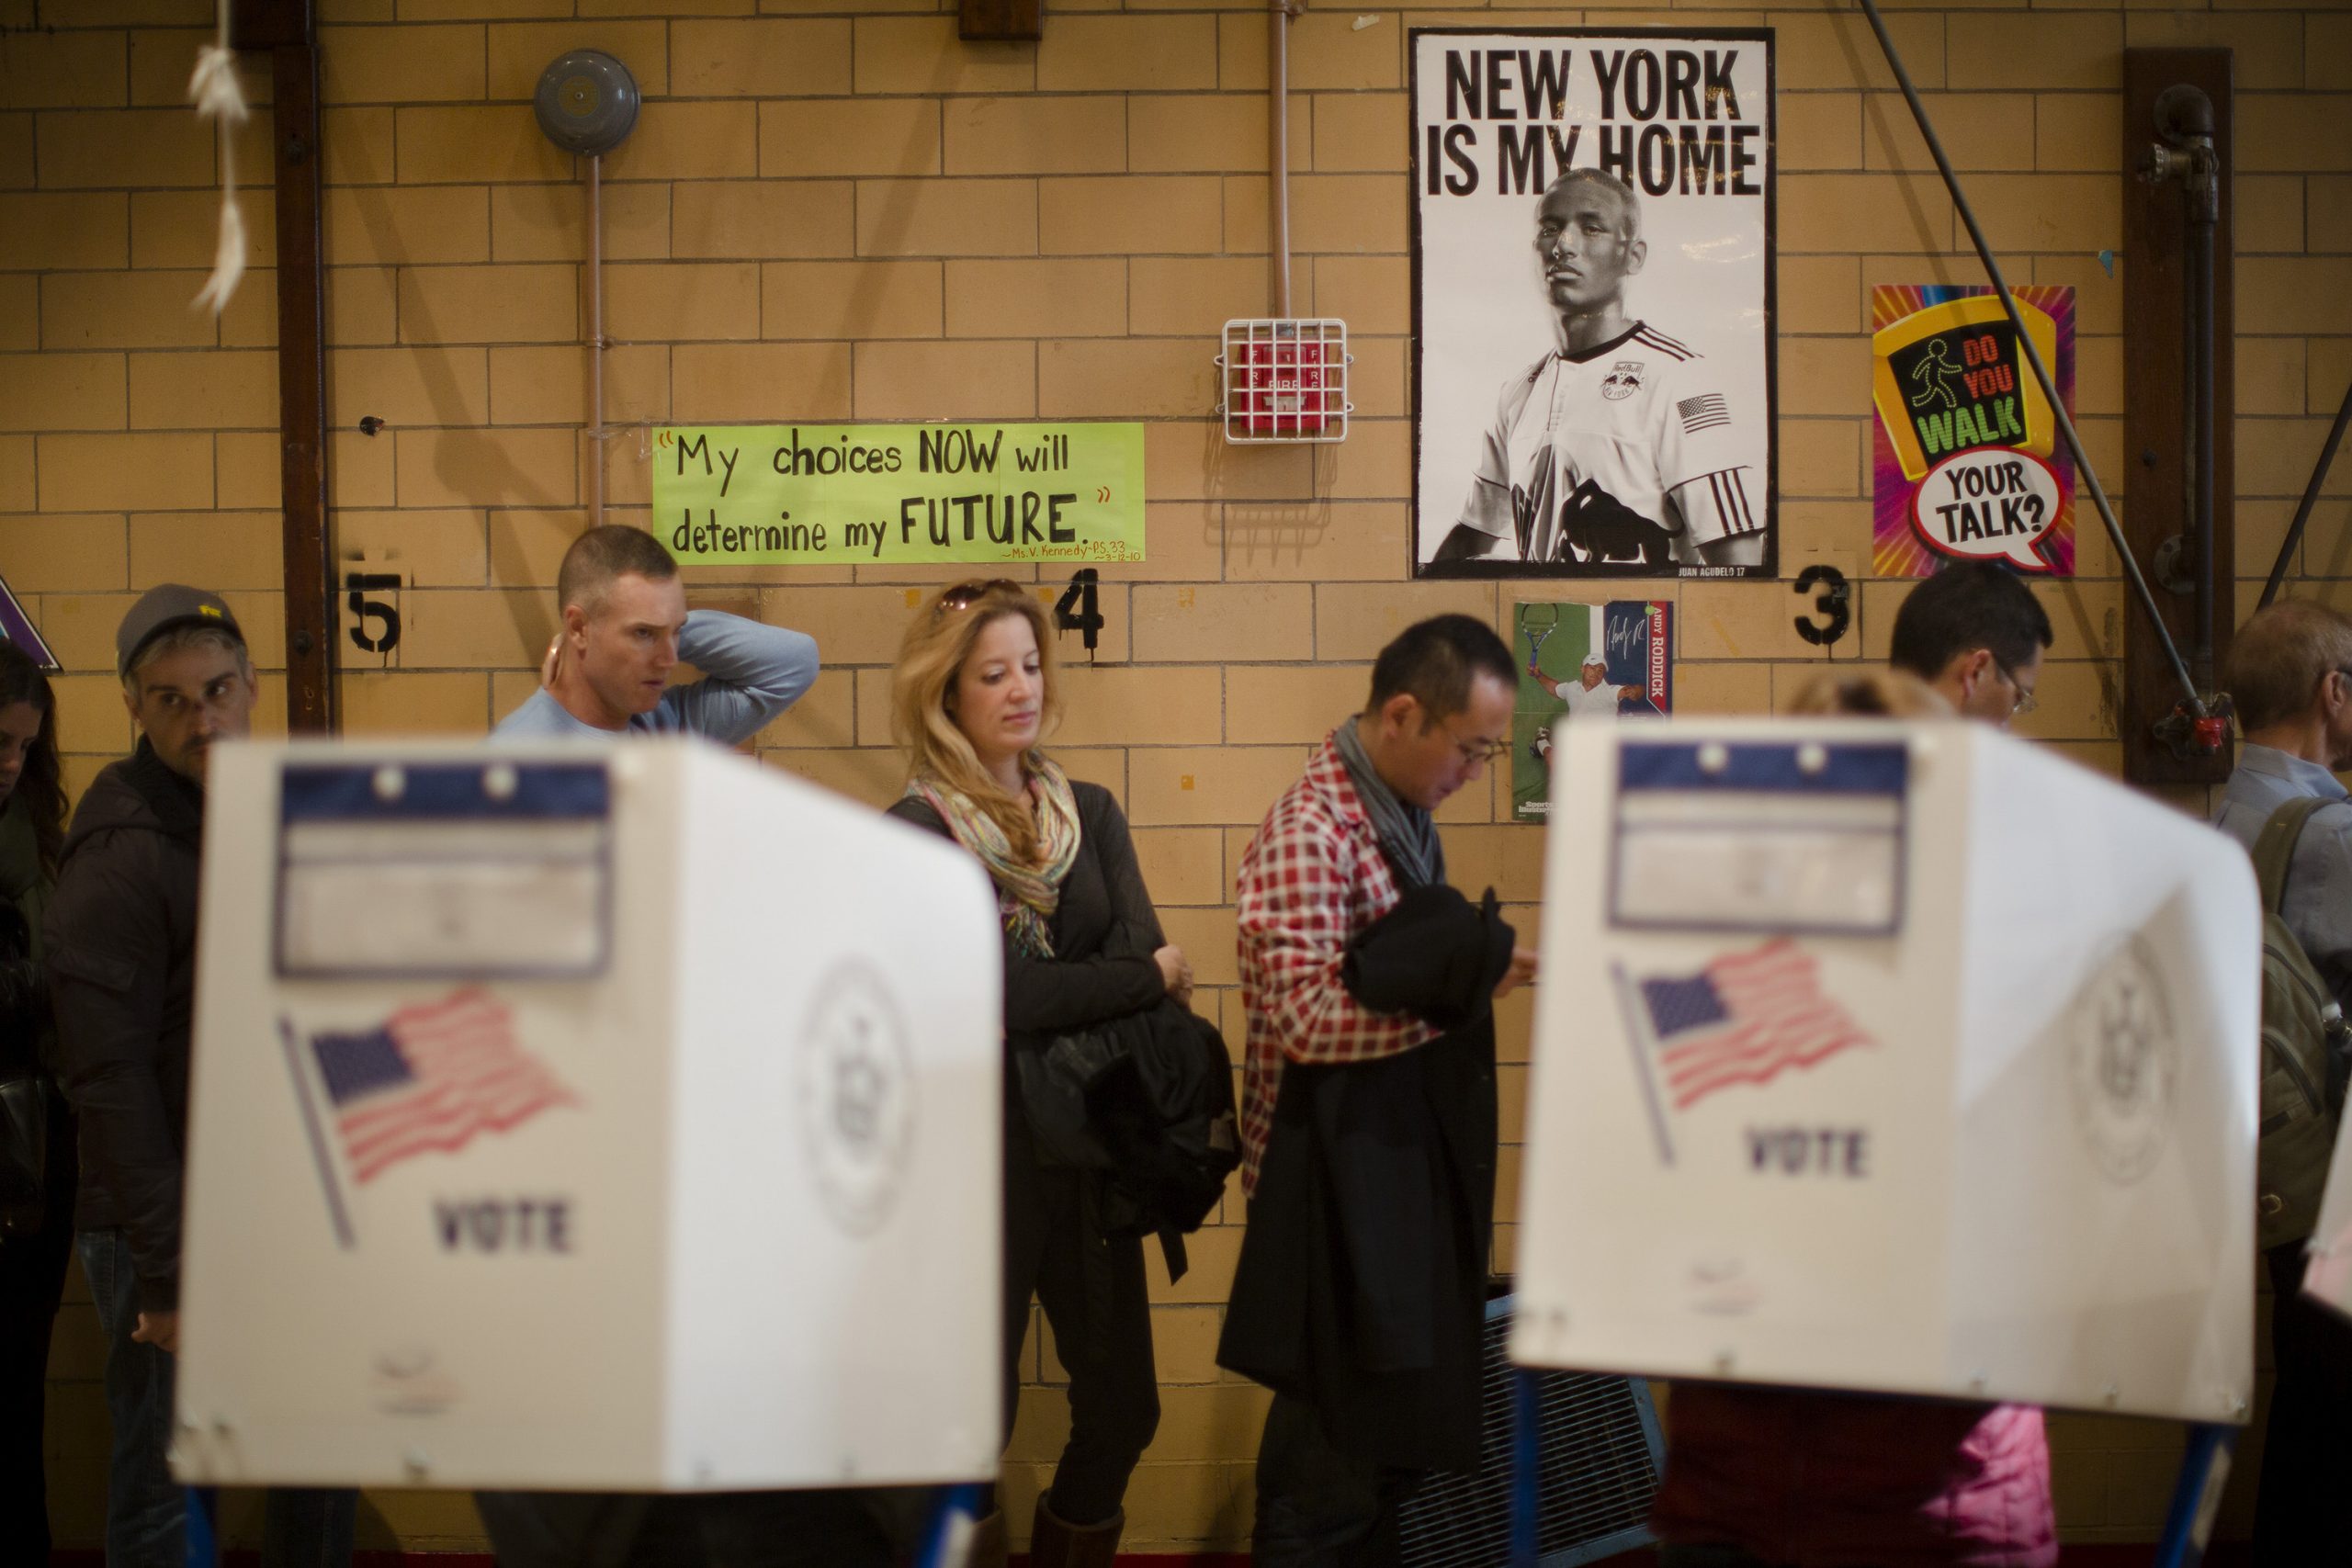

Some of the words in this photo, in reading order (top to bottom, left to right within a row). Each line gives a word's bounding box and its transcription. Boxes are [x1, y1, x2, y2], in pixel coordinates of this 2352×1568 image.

[1445, 49, 1571, 120] NEW
[1589, 49, 1742, 121] YORK
[1427, 123, 1479, 197] IS
[1498, 124, 1582, 196] MY
[1599, 124, 1761, 197] HOME
[1962, 334, 1997, 367] DO
[1963, 364, 2014, 400] YOU
[1917, 396, 2023, 455] WALK
[773, 428, 901, 476] choices
[920, 429, 1003, 474] NOW
[1015, 434, 1068, 471] will
[1945, 460, 2028, 502] YOUR
[673, 508, 826, 554] determine
[845, 520, 887, 558] my
[1936, 493, 2045, 544] TALK?
[1111, 540, 1125, 553] 33
[1679, 567, 1698, 577] JUAN
[1700, 567, 1735, 577] AGUDELO
[1736, 567, 1746, 577] 17
[347, 573, 401, 653] 5
[1053, 568, 1104, 650] 4
[1653, 607, 1663, 634] ANDY
[1793, 565, 1849, 647] 3
[1651, 637, 1665, 697] RODDICK
[1745, 1126, 1871, 1179] VOTE
[433, 1197, 577, 1256] VOTE
